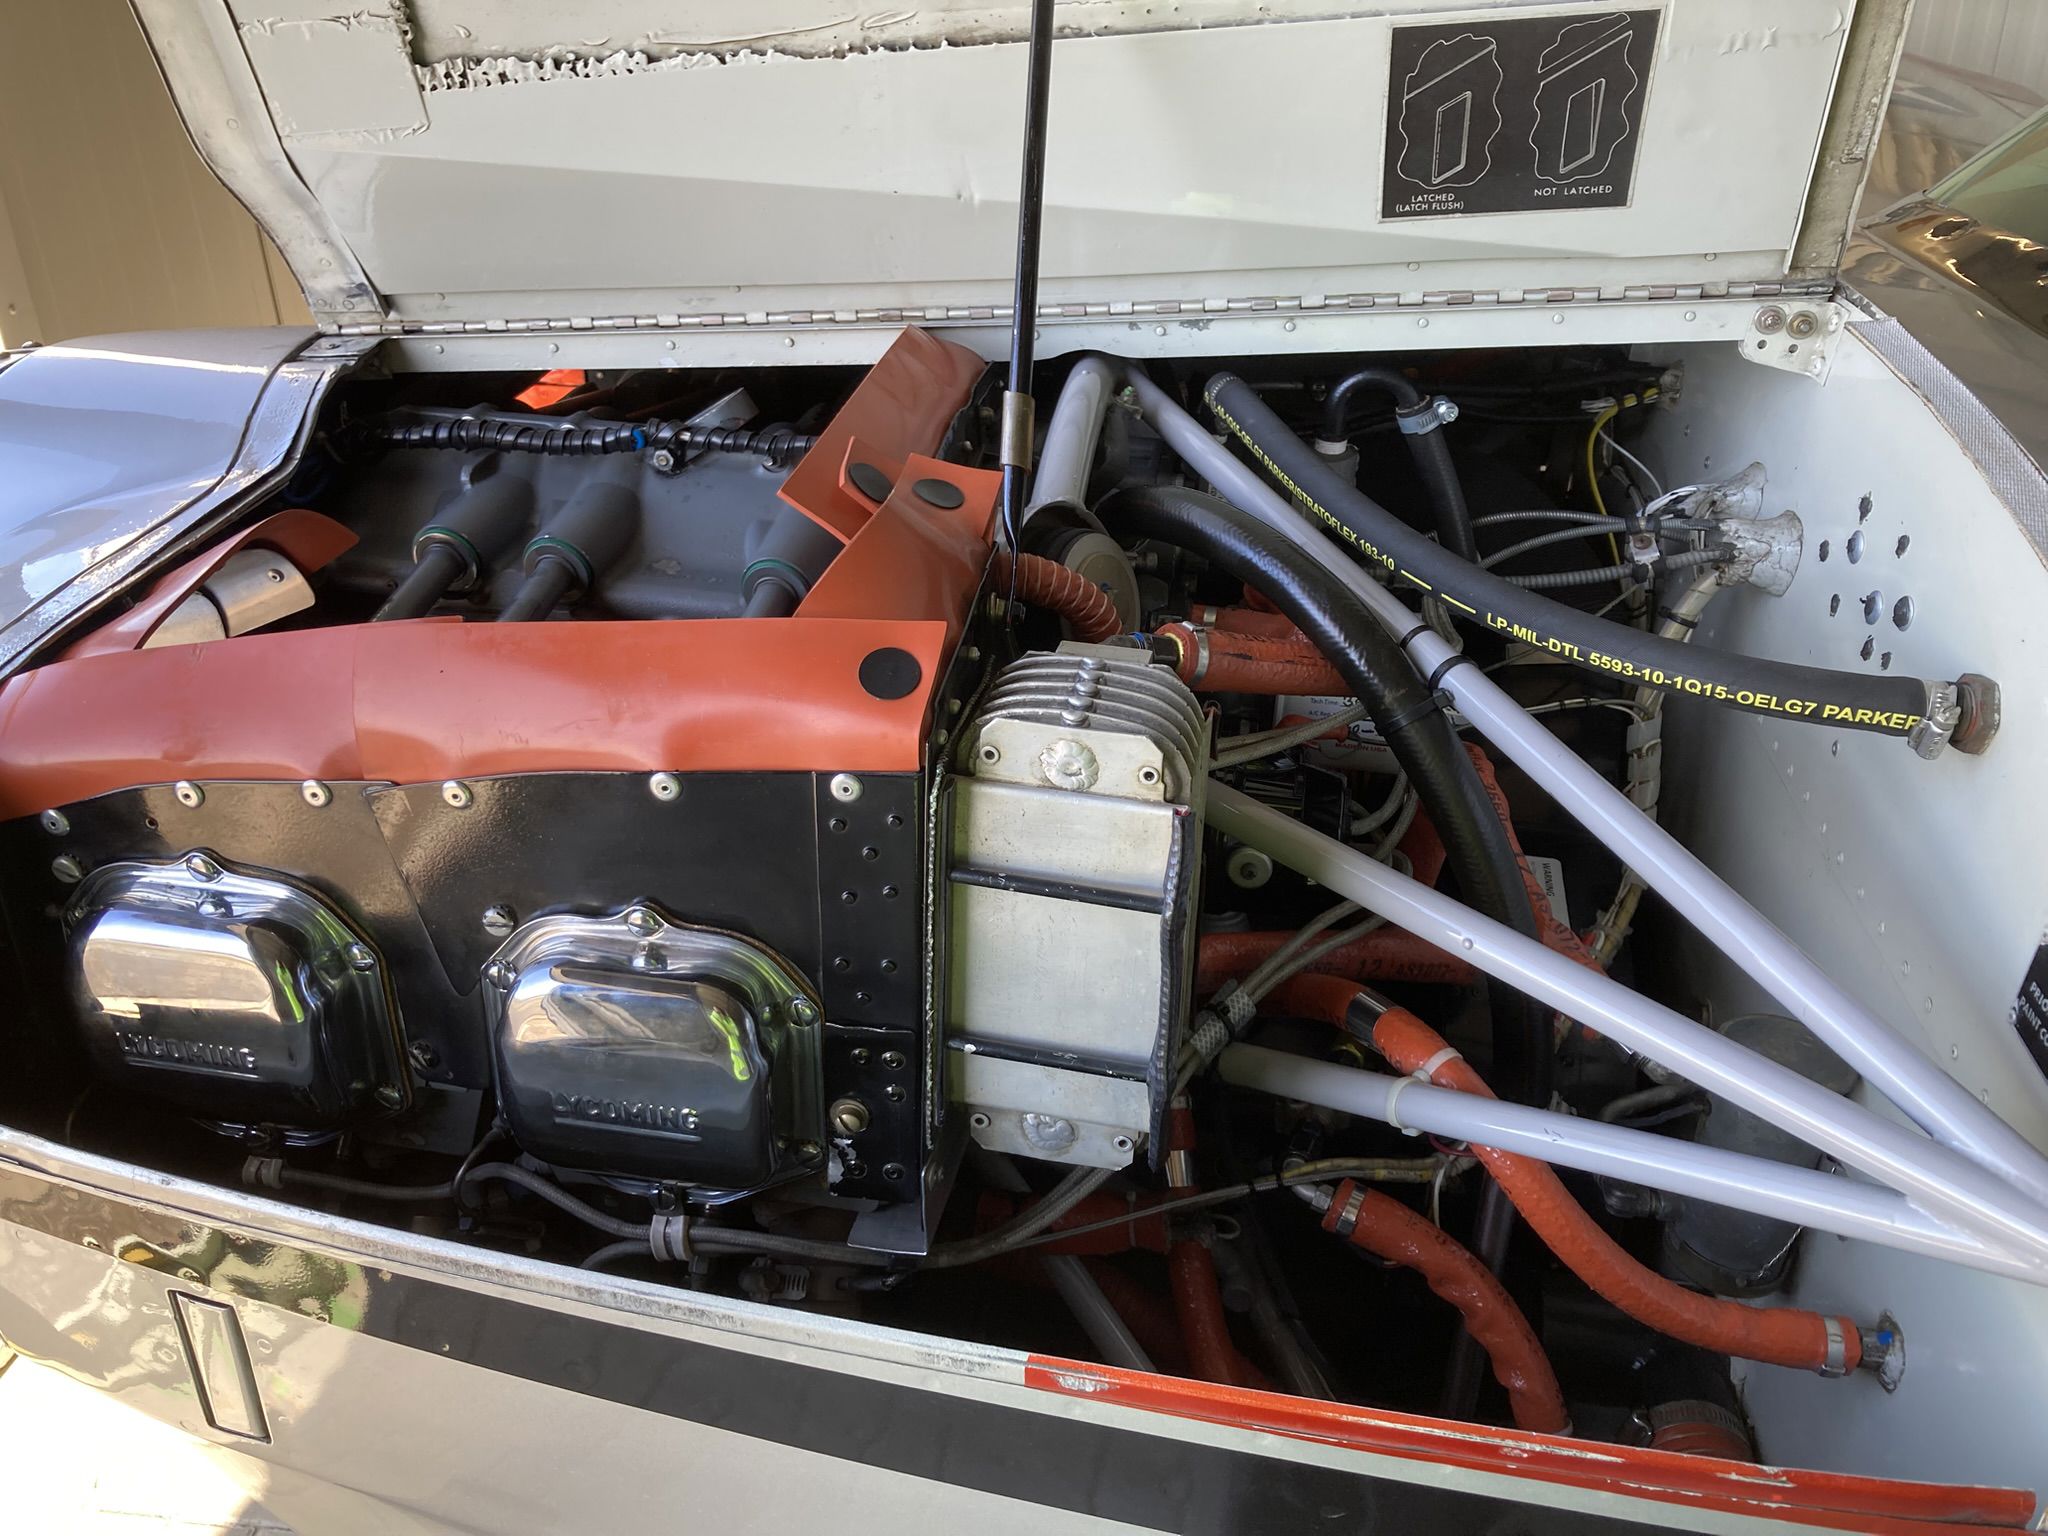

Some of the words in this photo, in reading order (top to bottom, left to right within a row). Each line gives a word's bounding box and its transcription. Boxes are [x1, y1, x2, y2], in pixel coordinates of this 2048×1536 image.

[1395, 203, 1429, 213] (LATCH
[1432, 201, 1464, 211] FLUSH)
[1411, 193, 1455, 203] LATCHED
[1534, 187, 1558, 197] NOT
[1564, 185, 1613, 196] LATCHED
[1360, 539, 1395, 571] 193-10
[1487, 612, 1584, 662] LP-MIL-DTL
[1589, 652, 1818, 716] 5593-10-1Q15-OELG7
[1541, 862, 1555, 897] WARNING
[2020, 996, 2042, 1031] PAINT
[115, 1031, 257, 1070] LYCOMING
[553, 1094, 700, 1130] LYCOMING
